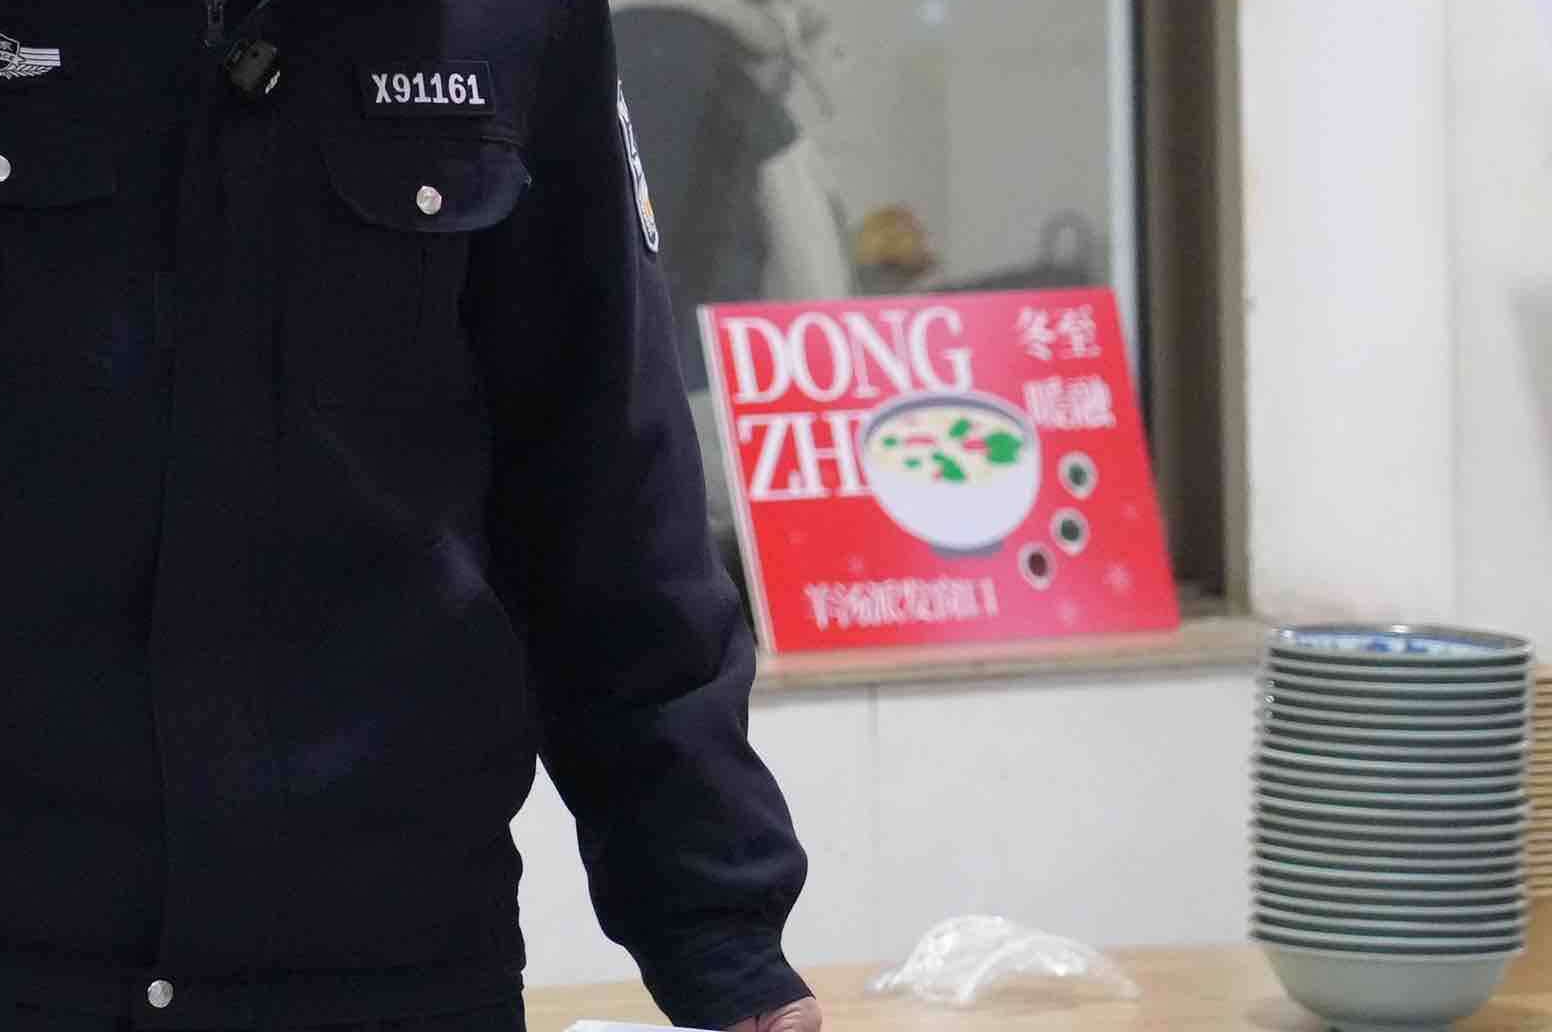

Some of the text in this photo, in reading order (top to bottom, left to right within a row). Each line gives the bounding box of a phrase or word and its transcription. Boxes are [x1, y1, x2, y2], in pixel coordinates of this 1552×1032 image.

[371, 72, 486, 105] X91161
[719, 306, 974, 404] DONG
[737, 409, 878, 502] ZH
